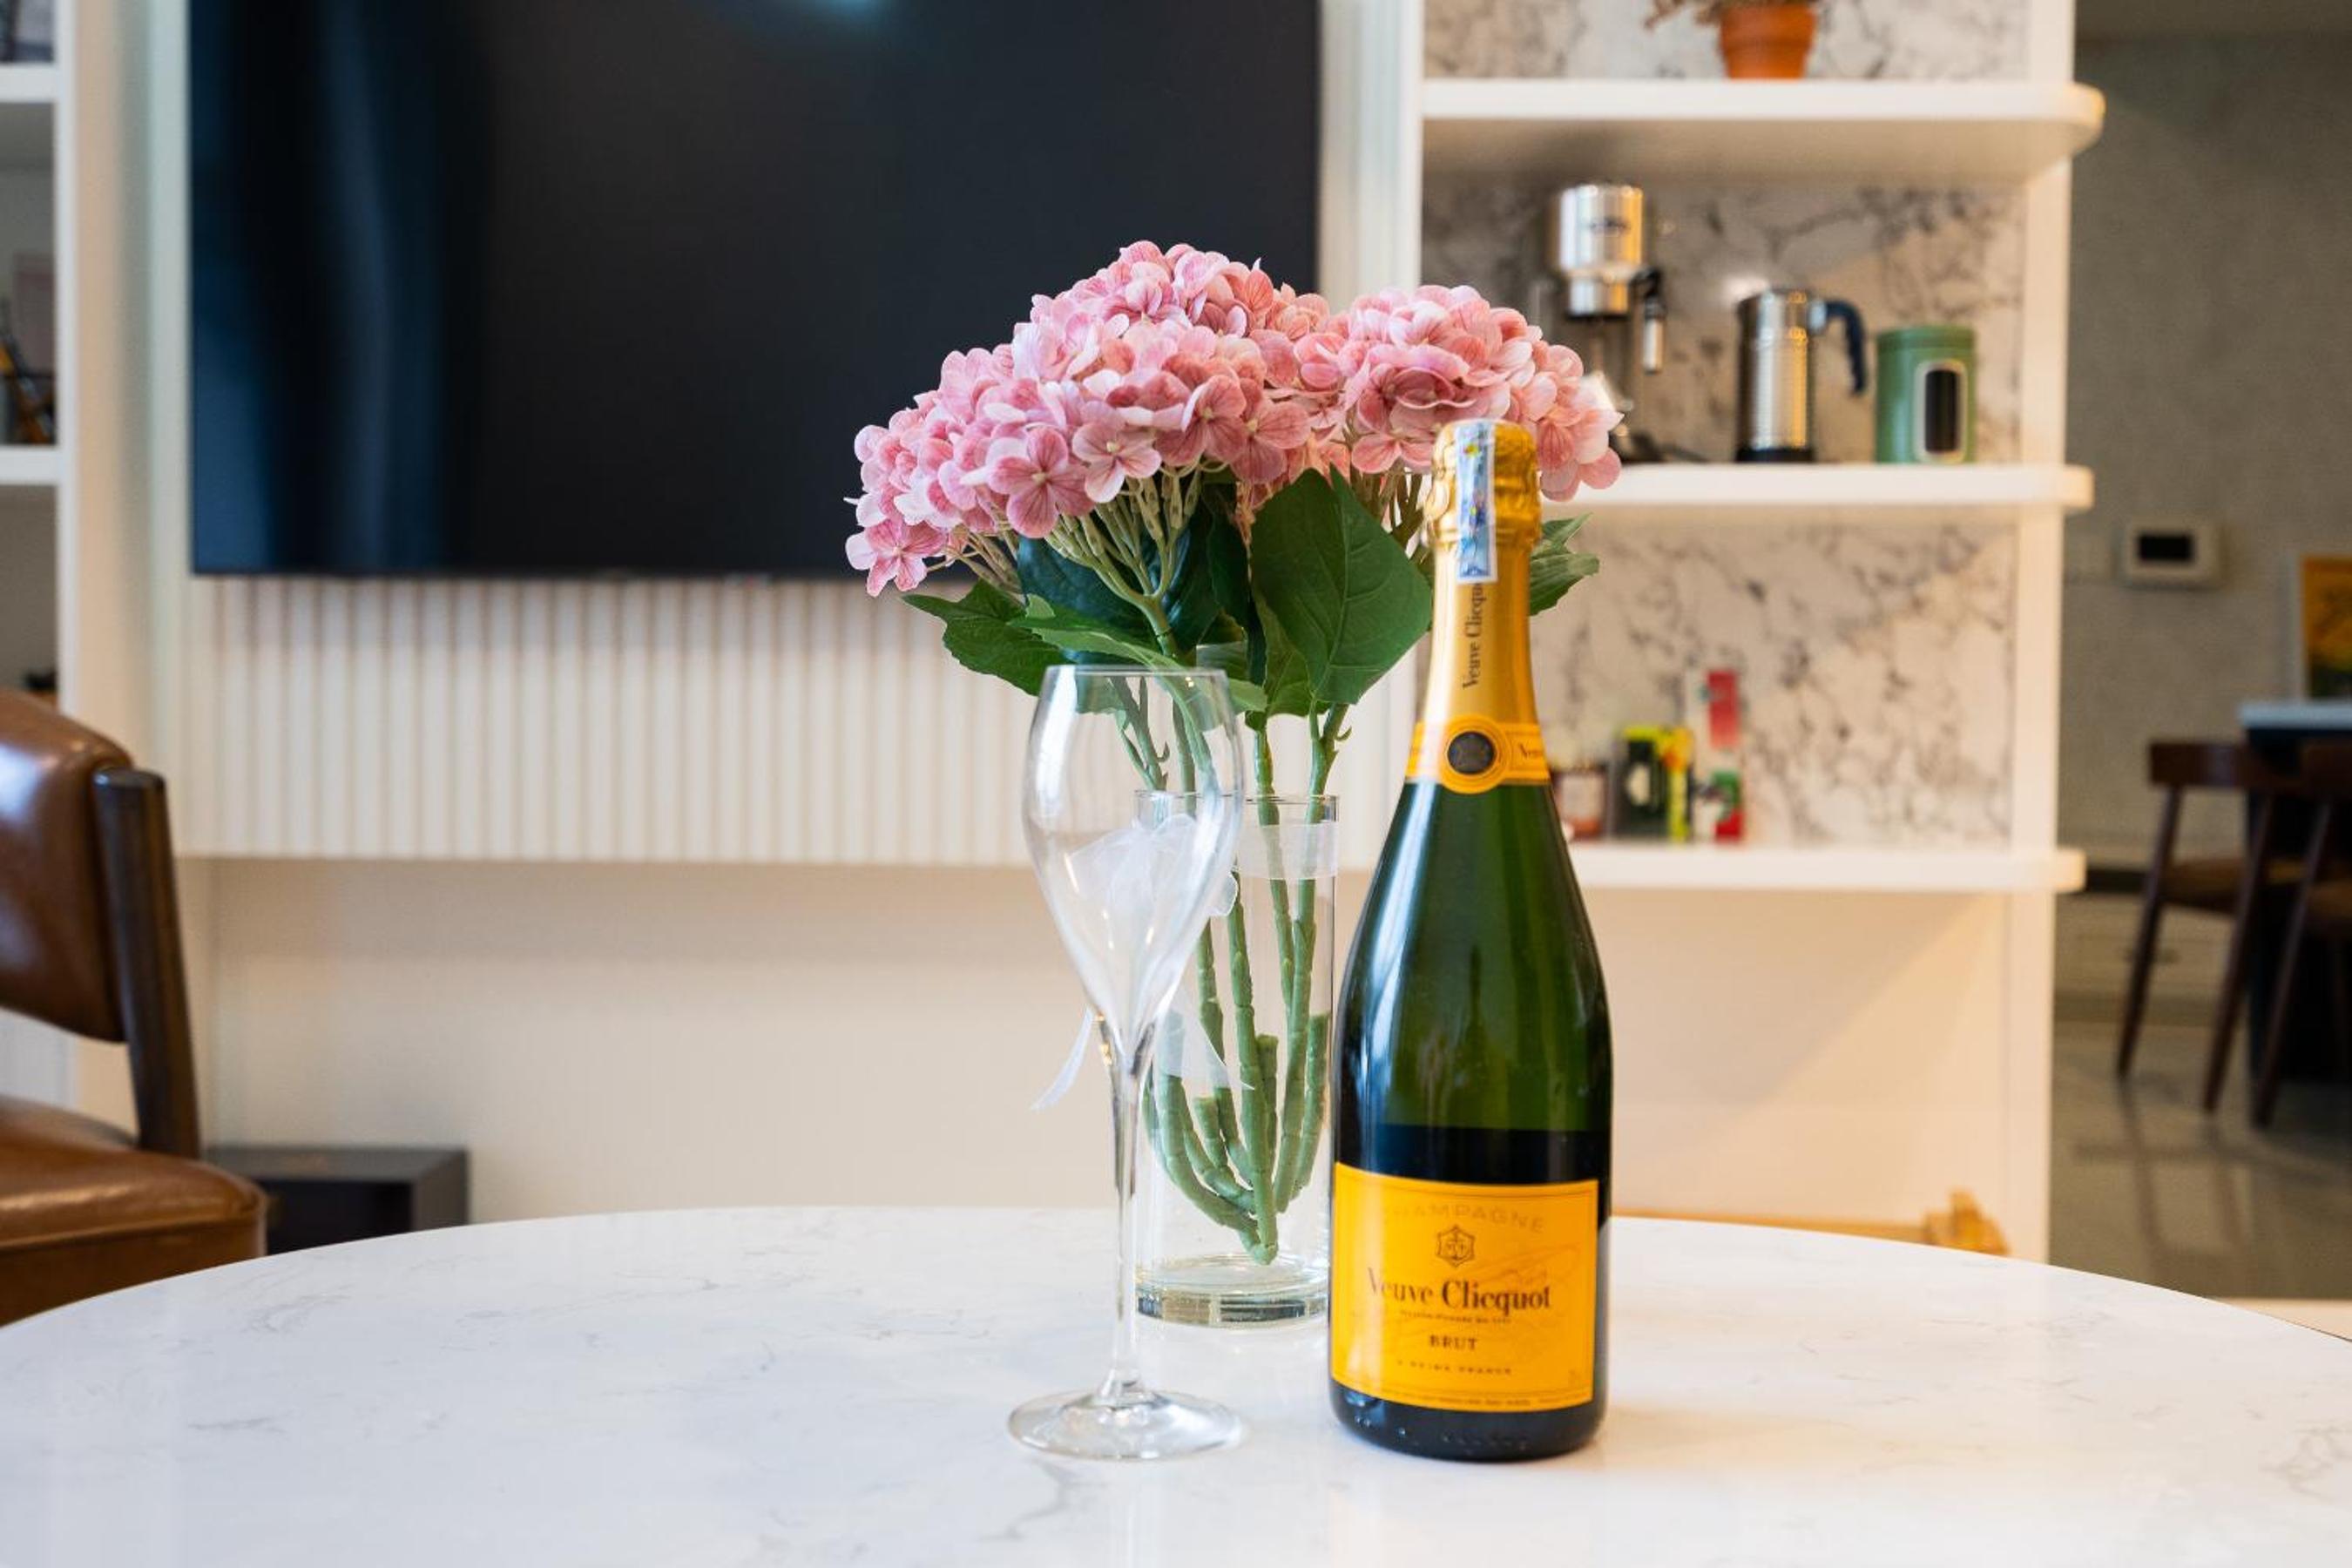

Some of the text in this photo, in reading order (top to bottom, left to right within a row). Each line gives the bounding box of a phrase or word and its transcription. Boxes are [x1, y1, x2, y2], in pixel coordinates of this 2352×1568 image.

[1462, 641, 1481, 690] Veuve
[1382, 1203, 1545, 1232] HAMPAGNE
[1367, 1267, 1551, 1316] Veuve Clicquot
[1429, 1335, 1478, 1351] BRUT
